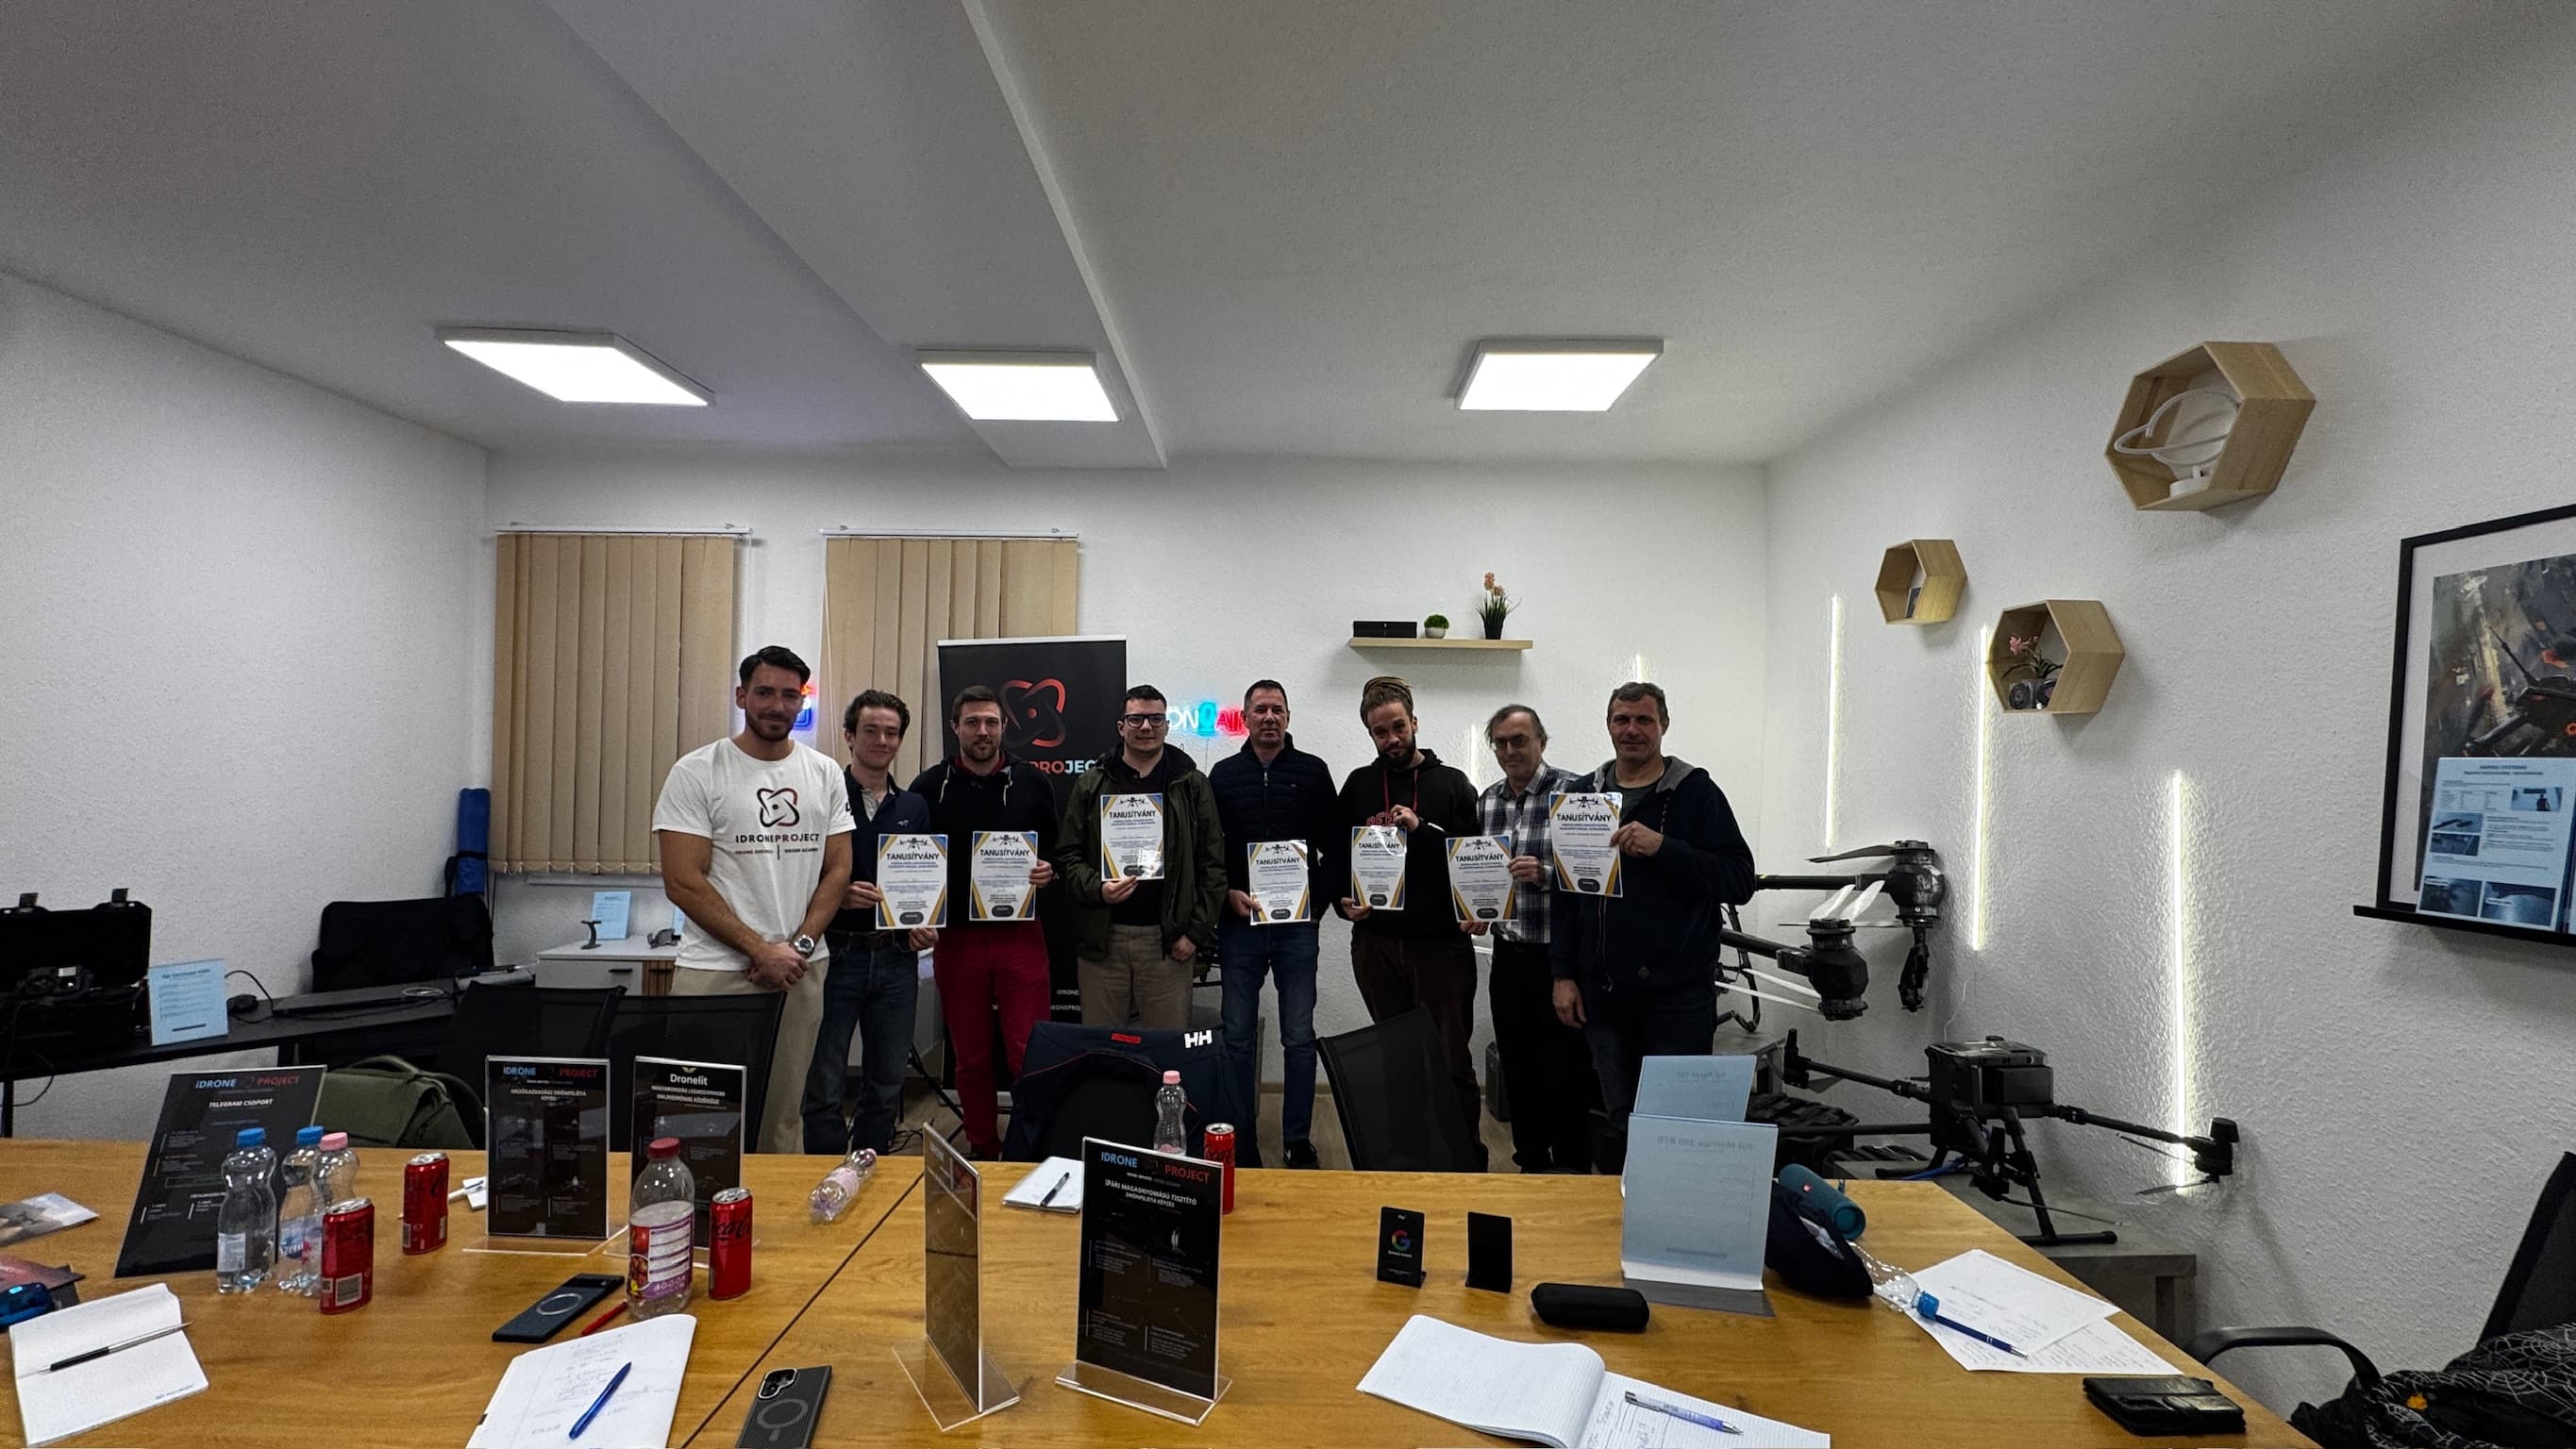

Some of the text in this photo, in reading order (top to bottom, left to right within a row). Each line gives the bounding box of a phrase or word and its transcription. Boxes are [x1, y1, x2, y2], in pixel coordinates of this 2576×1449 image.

[1166, 708, 1199, 729] ON
[1109, 808, 1157, 819] TANUSÍTVÁNY
[1556, 812, 1612, 822] TANUSÍTVÁNY
[735, 833, 820, 843] IDRONEPROJECT
[886, 852, 940, 860] TANUSÍTVÁNY
[980, 847, 1030, 857] TANUSÍTVÁNY
[1455, 853, 1504, 862] TANUSÍTVÁNY
[1255, 857, 1300, 865] TANUSÍTVÁNY
[1184, 1029, 1213, 1048] HH
[503, 1066, 598, 1077] IDRONE PROJECT
[257, 1075, 301, 1086] PROJECT
[670, 1074, 709, 1086] Dronelit
[1101, 1151, 1138, 1169] IDRONE
[1164, 1165, 1210, 1184] PROJECT
